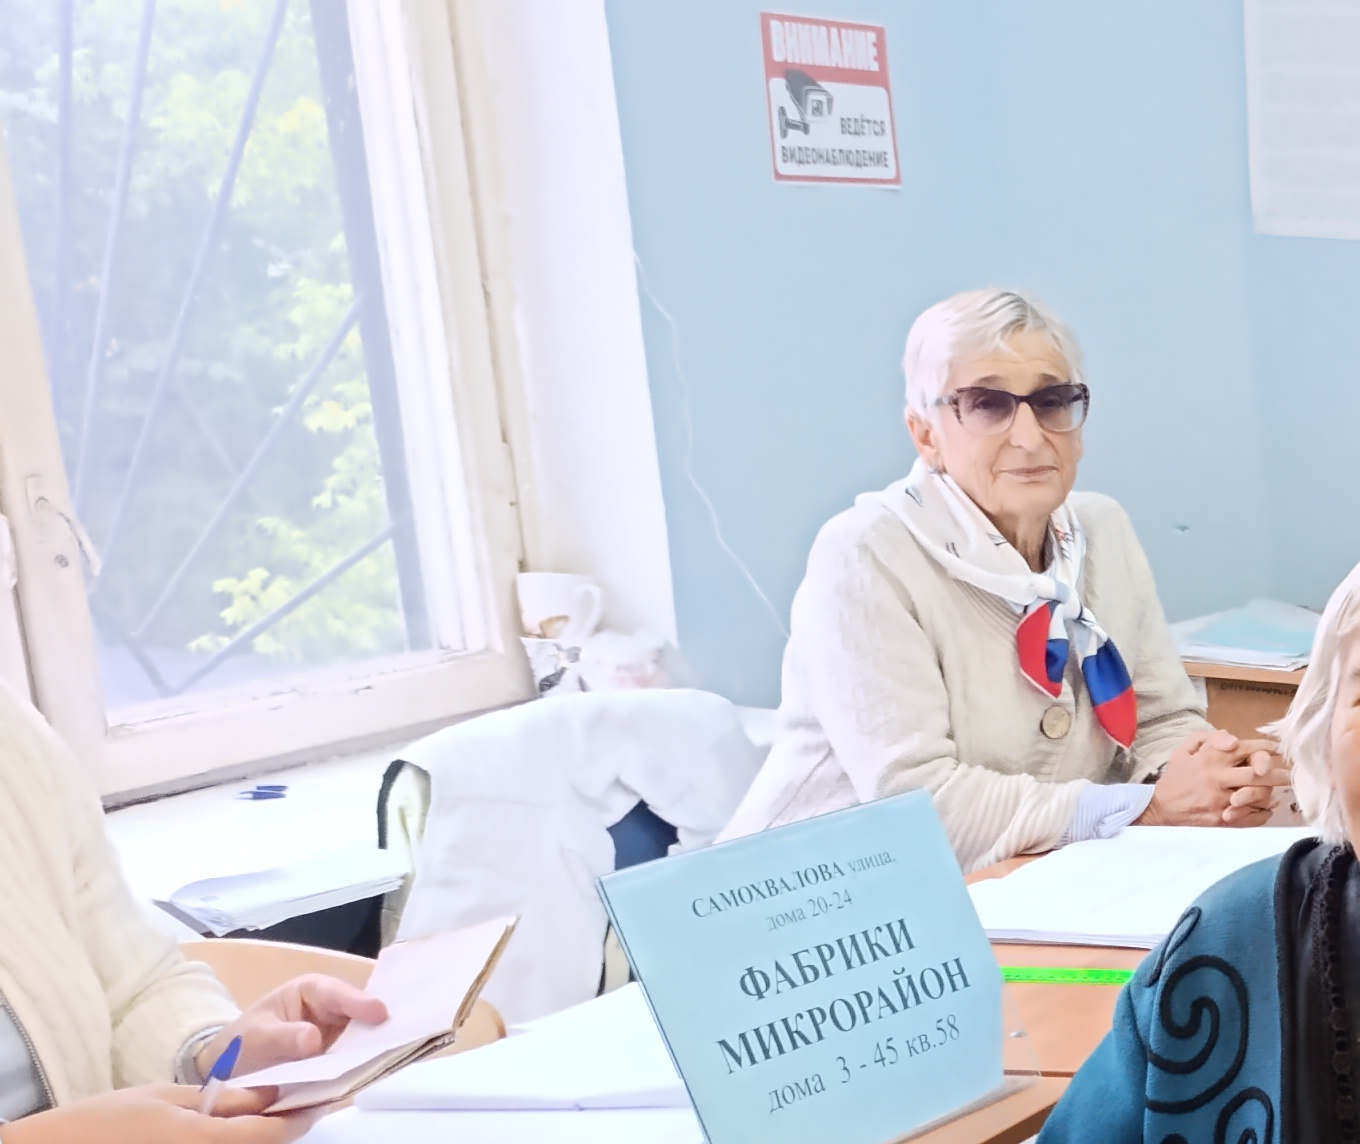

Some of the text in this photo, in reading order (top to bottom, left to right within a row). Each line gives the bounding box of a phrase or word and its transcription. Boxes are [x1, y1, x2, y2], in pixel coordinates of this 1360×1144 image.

[769, 20, 880, 71] ВНИМАНИЕ
[840, 114, 887, 137] ВЕДЁТСЯ
[781, 145, 890, 169] ВИДЕОНАБЛЮДЕНИЕ
[692, 861, 845, 919] САМОХВАЛОВА
[765, 889, 854, 932] дома 20-24
[739, 917, 917, 1001] ФАБРИКИ
[716, 956, 972, 1075] МИКРОРАЙОН
[768, 1073, 827, 1115] дома
[835, 1056, 852, 1085] 3
[872, 1036, 899, 1067] 45
[905, 1014, 961, 1056] кв.58
